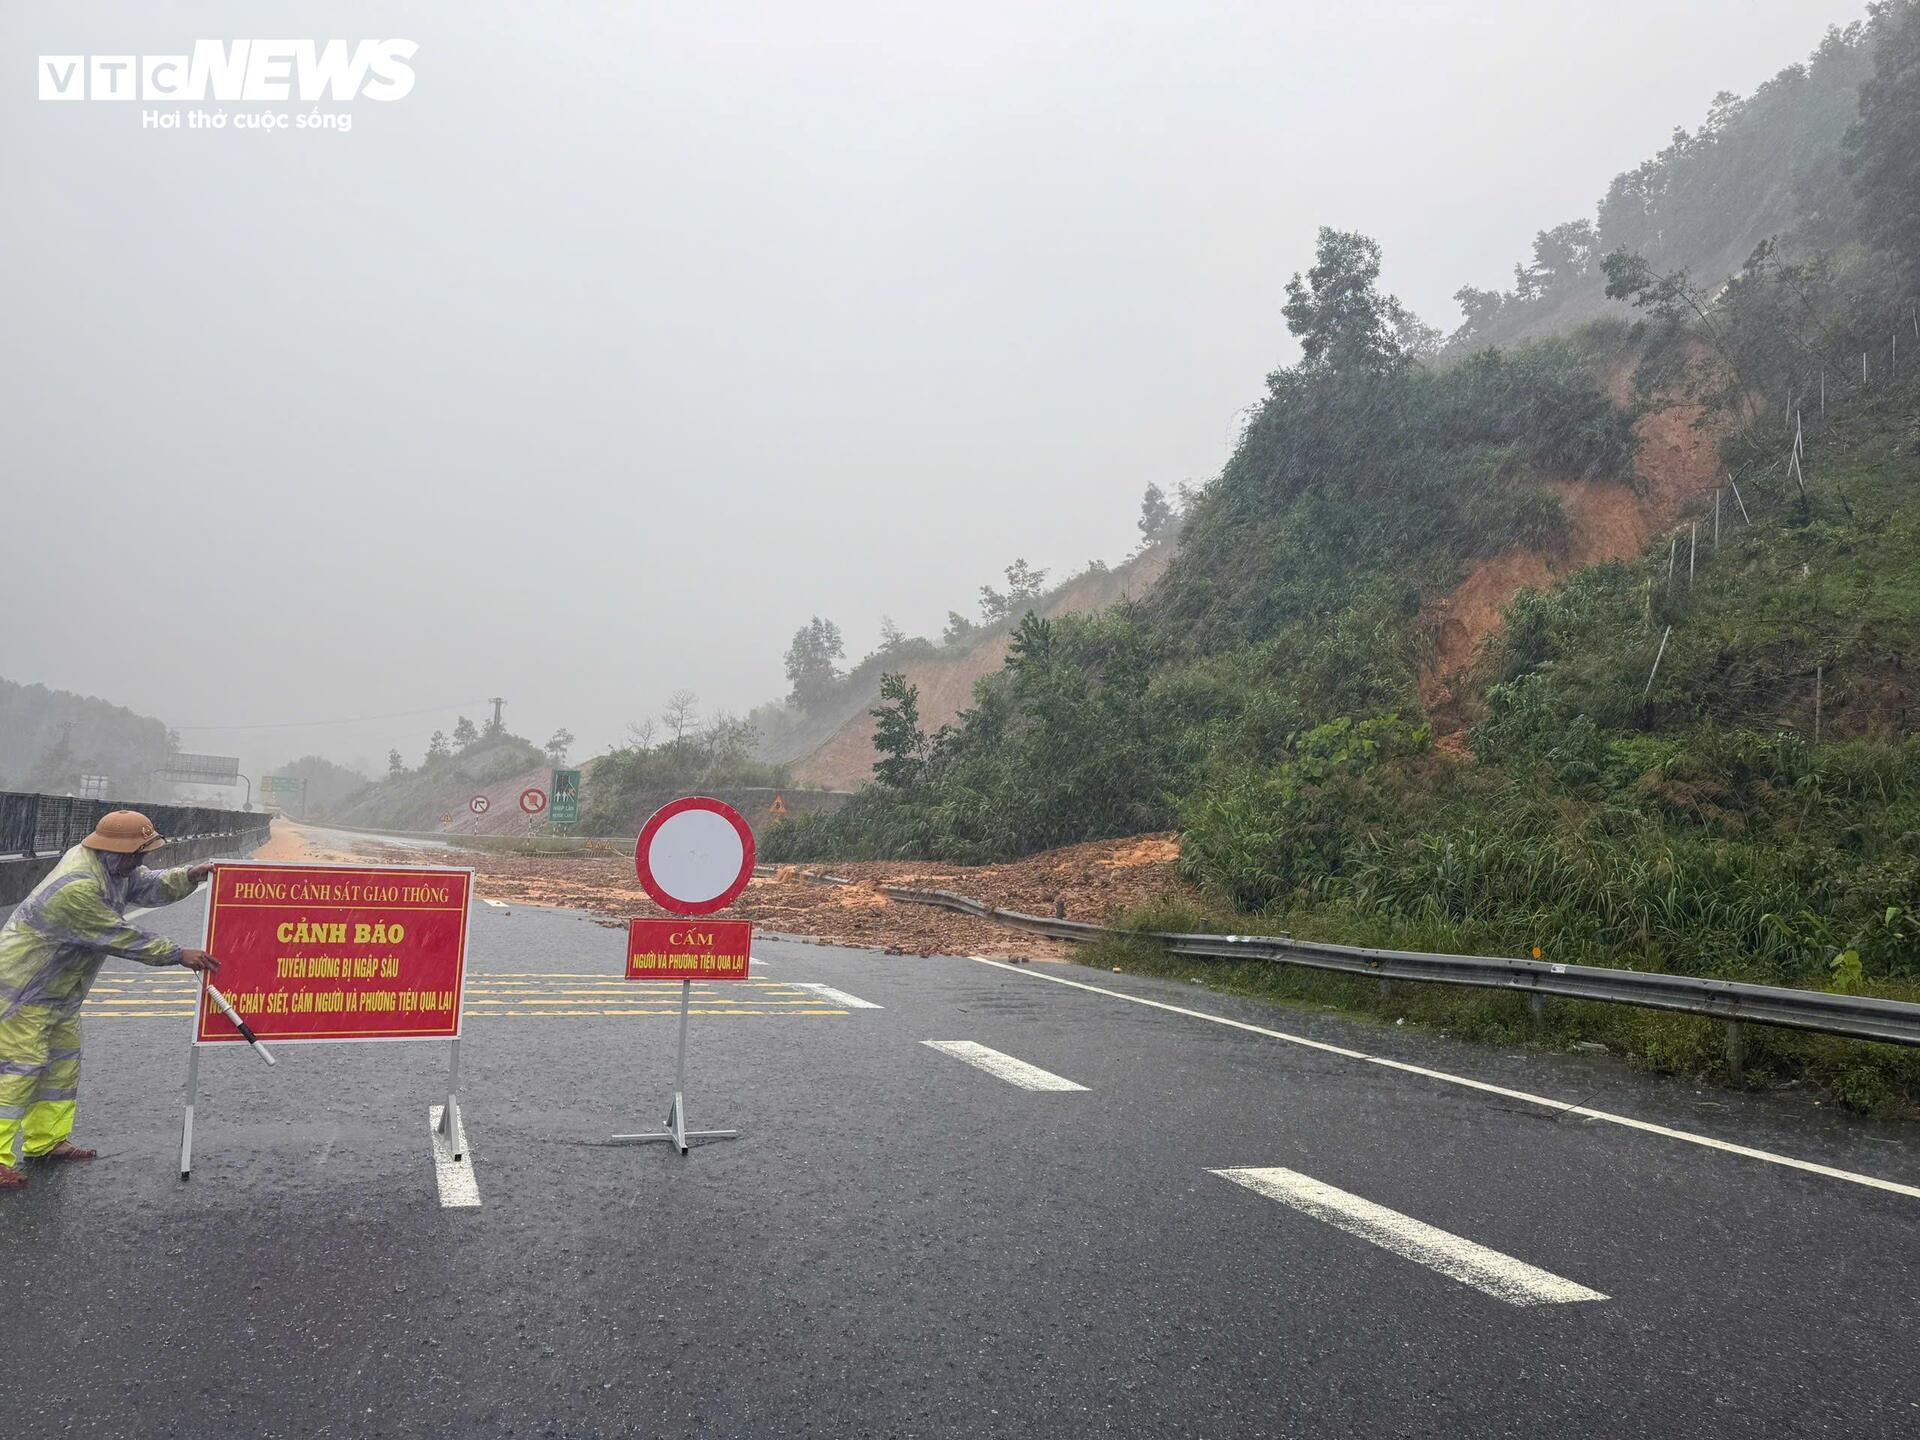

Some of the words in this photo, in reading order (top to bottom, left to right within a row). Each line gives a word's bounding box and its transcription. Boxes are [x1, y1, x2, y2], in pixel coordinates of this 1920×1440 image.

[234, 878, 287, 900] PHÒNG
[290, 880, 331, 901] CẢNH
[333, 881, 360, 901] SÁT
[363, 885, 399, 902] GIAO
[401, 883, 449, 903] THÔNG
[276, 917, 347, 944] CẢNH
[353, 919, 405, 944] BÁO
[669, 927, 714, 946] CẤM
[277, 952, 306, 978] TUYẾN
[308, 953, 340, 980] ĐƯỜNG
[342, 957, 351, 982] BỊ
[353, 954, 379, 982] NGẬP
[380, 954, 399, 978] SÂU
[633, 951, 656, 969] NGƯỜI
[657, 951, 667, 969] VÀ
[668, 953, 698, 969] PHƯƠNG
[700, 952, 716, 972] TIỆN
[717, 955, 731, 971] QUA
[732, 955, 744, 973] LẠI
[240, 986, 266, 1013] CHẢY
[267, 986, 288, 1015] SIẾT,
[291, 986, 314, 1013] CẤM
[315, 987, 344, 1012] NGƯỜI
[359, 989, 396, 1012] PHƯƠNG
[398, 987, 418, 1015] TIỆN
[419, 991, 437, 1013] QUA
[438, 991, 452, 1015] LẠI
